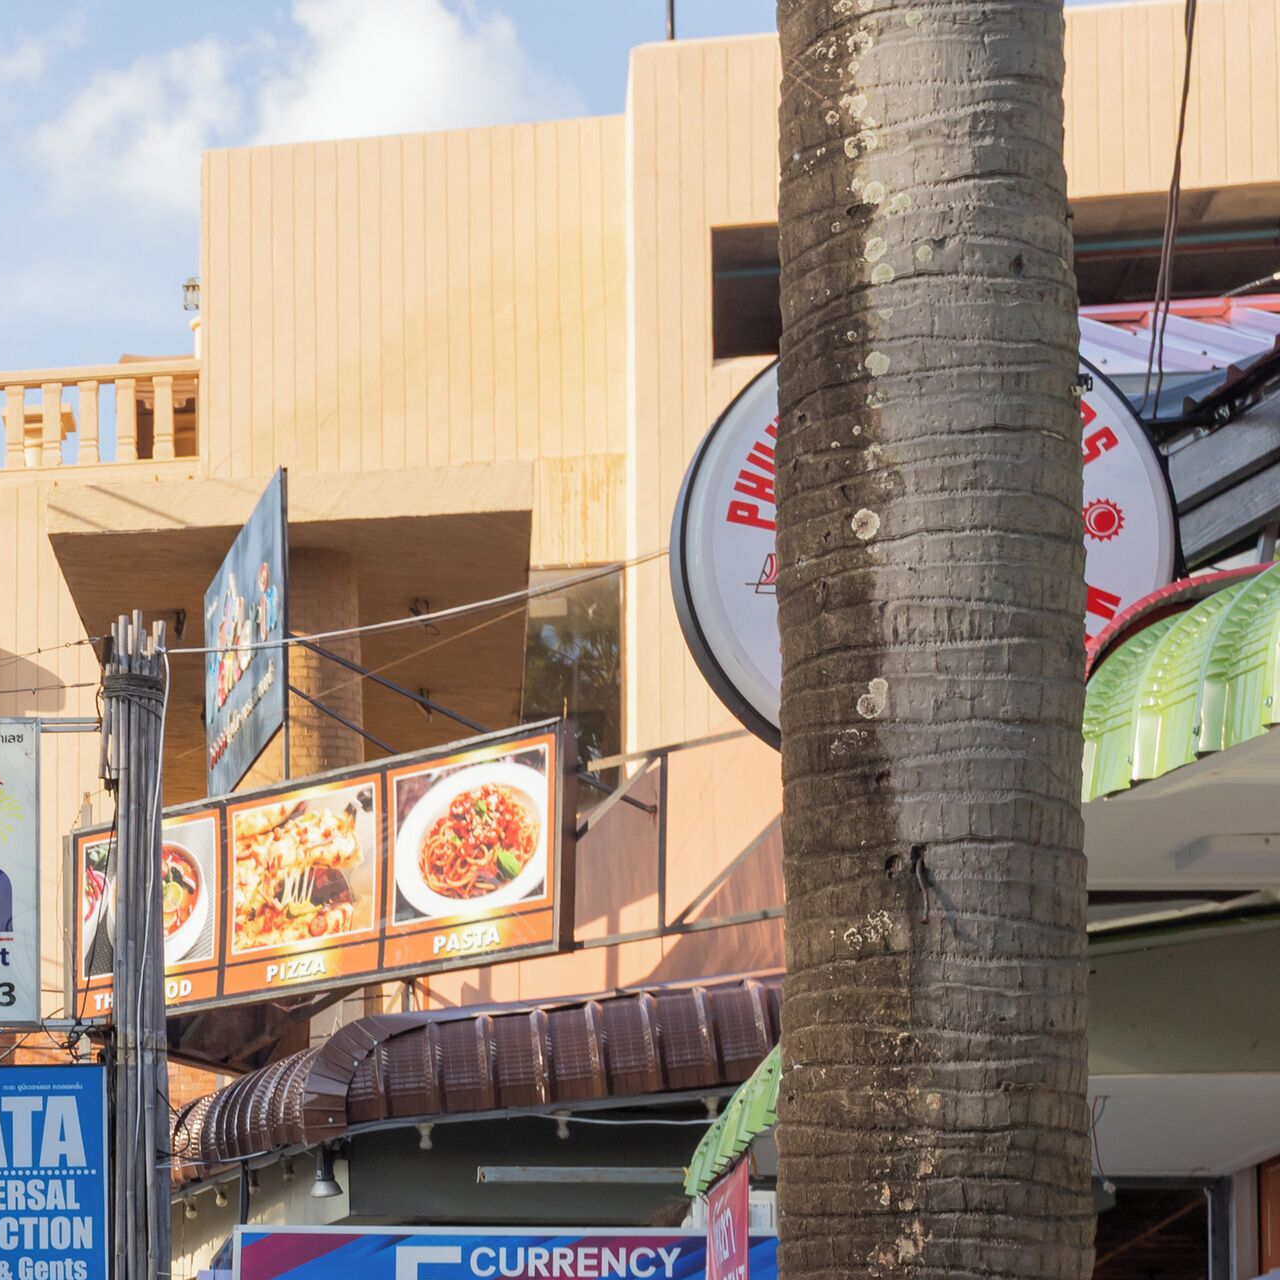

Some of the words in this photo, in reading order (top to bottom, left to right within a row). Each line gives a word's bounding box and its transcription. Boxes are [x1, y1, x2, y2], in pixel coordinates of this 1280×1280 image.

[433, 926, 502, 955] PASTA
[266, 958, 328, 984] PIZZA
[94, 993, 114, 1011] TH
[165, 977, 192, 999] OD
[470, 1246, 682, 1278] CURRENCY
